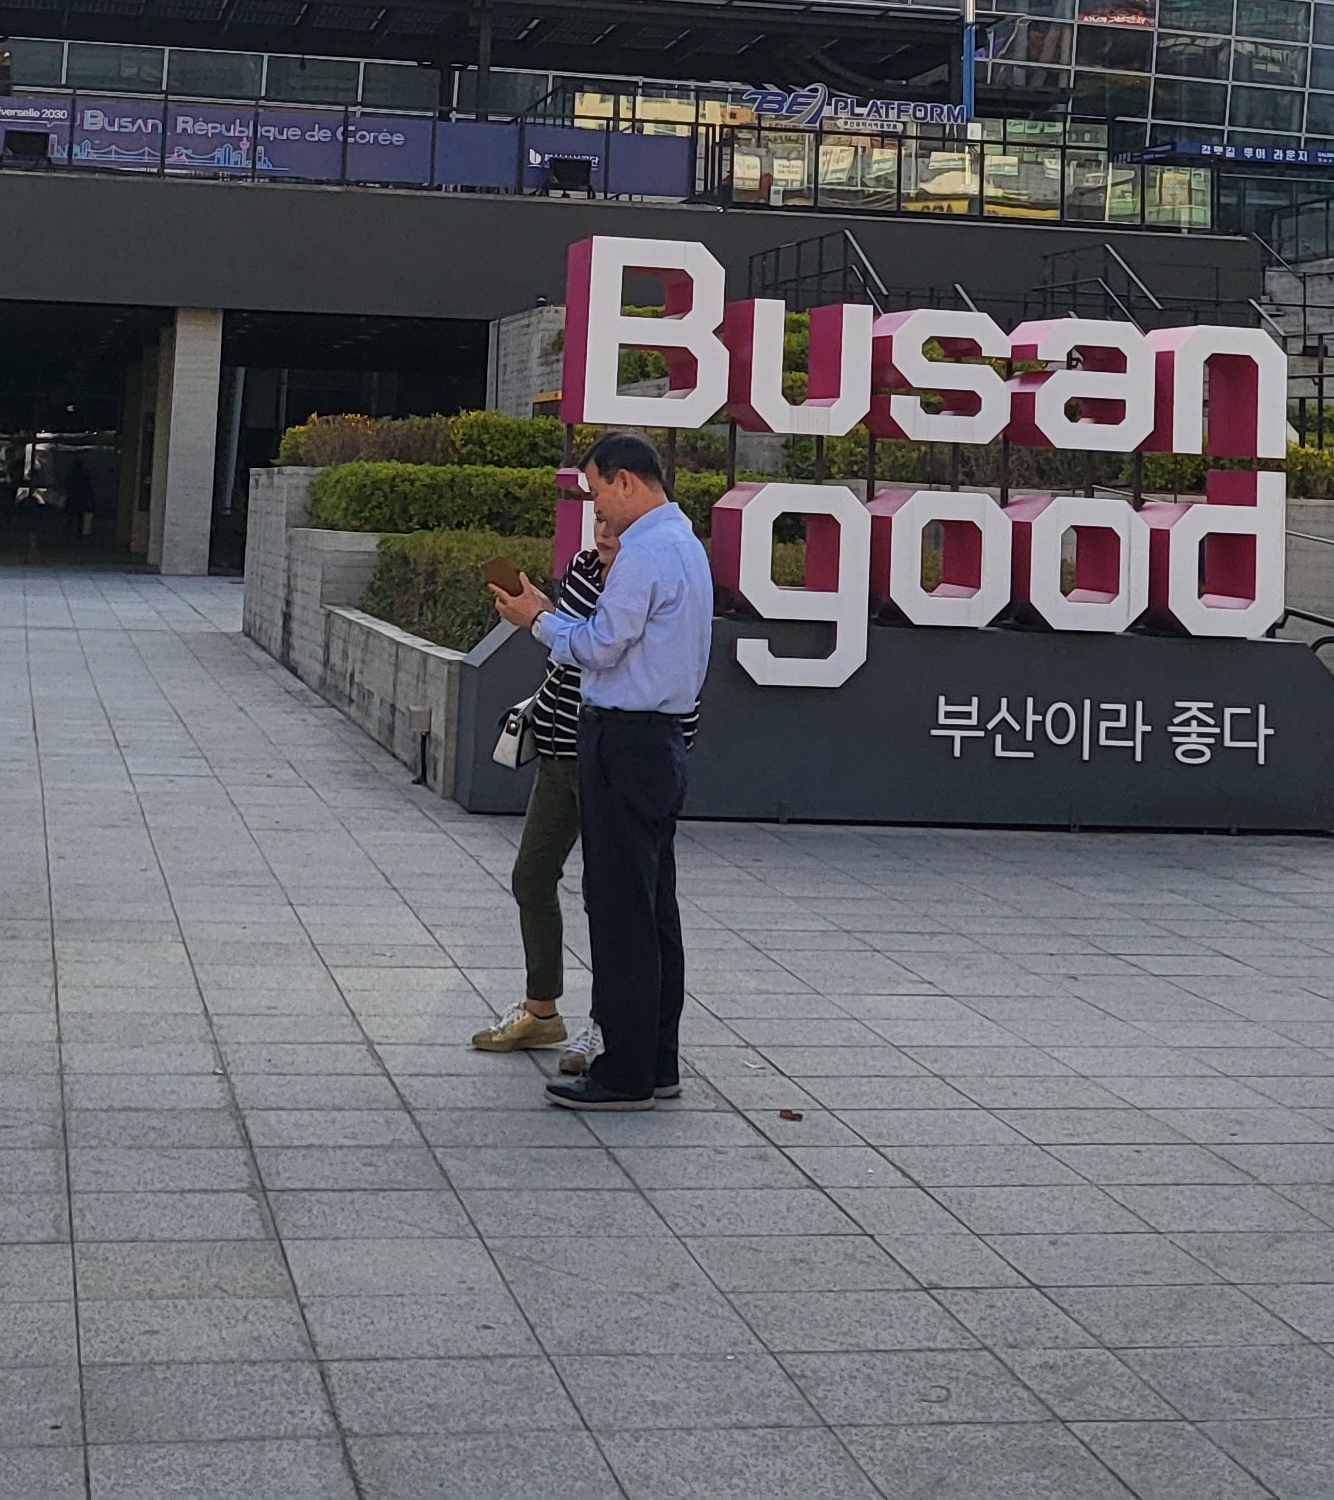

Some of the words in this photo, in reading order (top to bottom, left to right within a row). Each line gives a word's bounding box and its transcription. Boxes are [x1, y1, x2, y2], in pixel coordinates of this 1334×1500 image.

[41, 108, 68, 119] 2030
[831, 97, 967, 125] PLATFORM
[304, 123, 332, 142] de
[1244, 147, 1266, 159] 투어
[1274, 149, 1308, 162] 라운지
[561, 235, 1288, 459] Busan
[712, 471, 1287, 687] good
[929, 692, 1152, 765] 부산이라
[1166, 699, 1275, 766] 좋다
